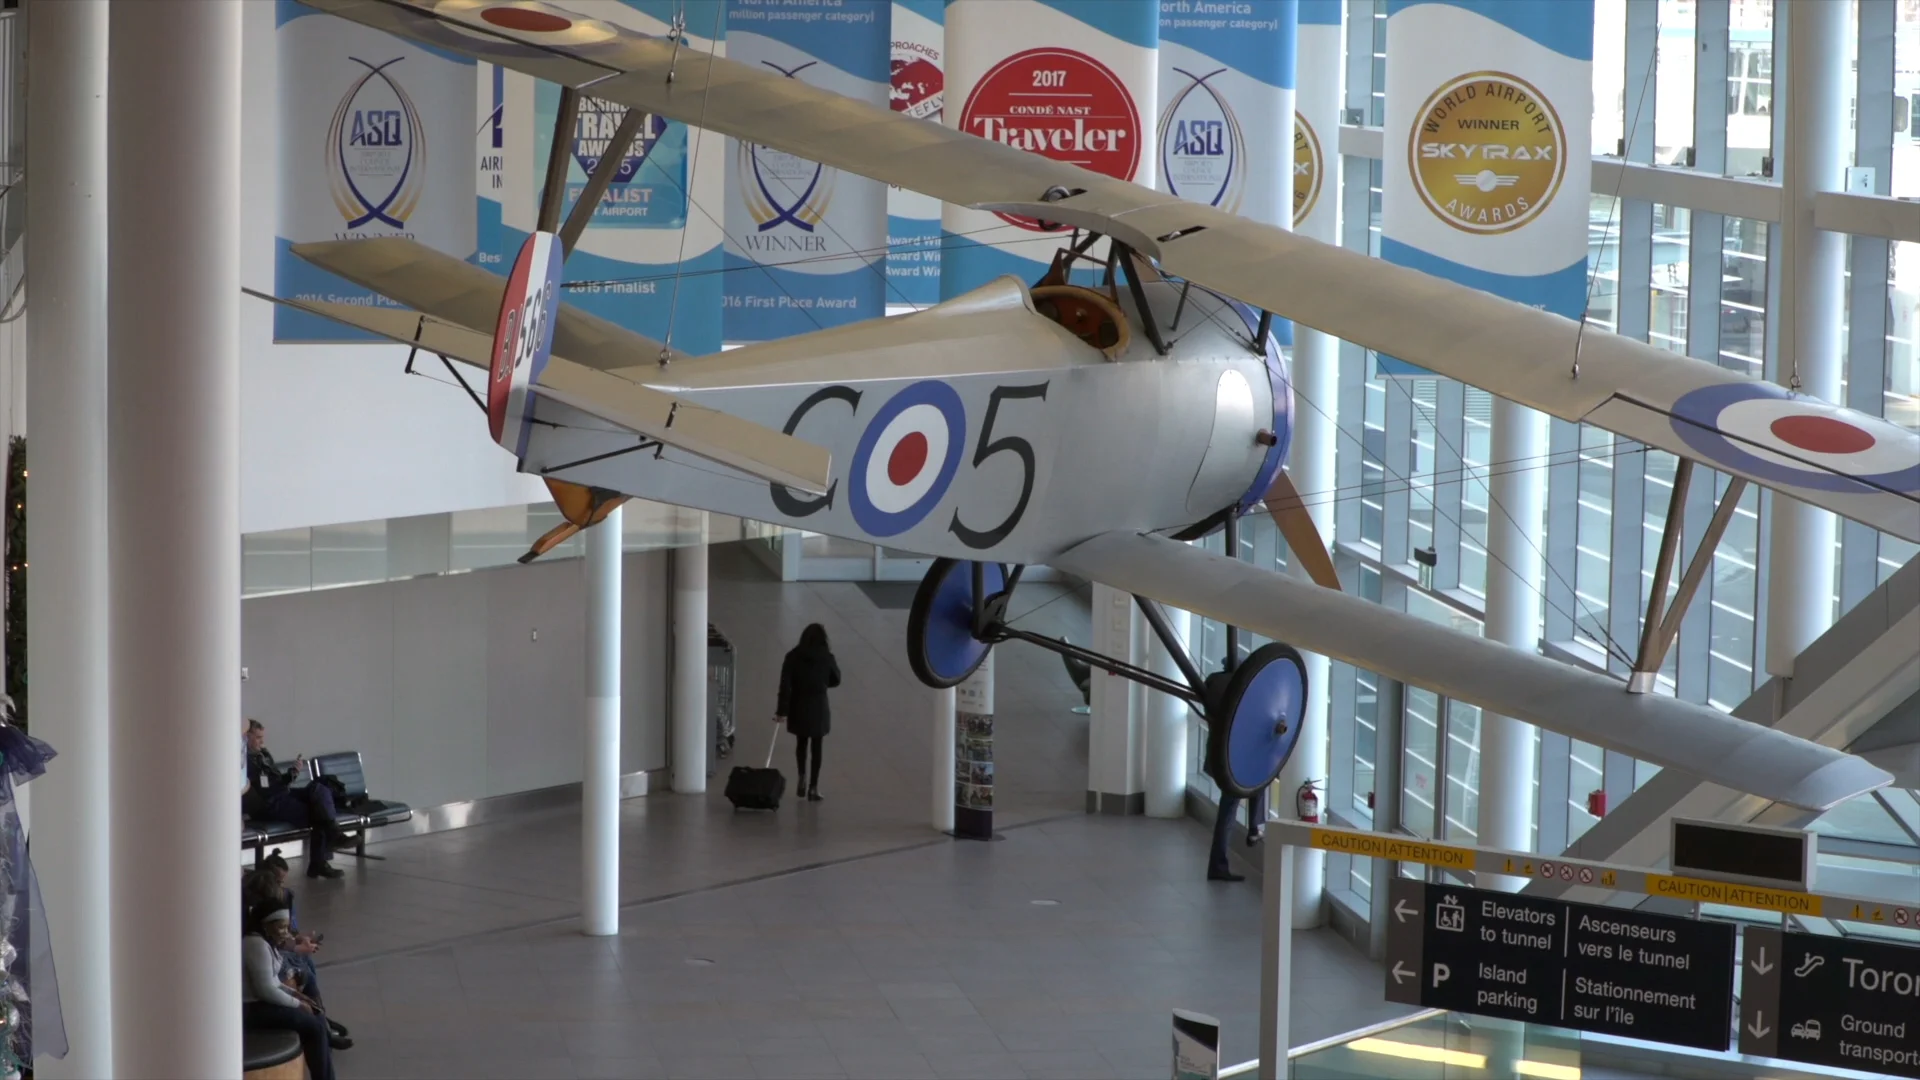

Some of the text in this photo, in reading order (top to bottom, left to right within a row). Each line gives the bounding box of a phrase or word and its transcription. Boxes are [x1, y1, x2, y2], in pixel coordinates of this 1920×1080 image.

[729, 9, 765, 19] million
[768, 11, 821, 22] passenger
[1159, 0, 1251, 14] orth America
[1173, 19, 1226, 29] passenger
[1032, 70, 1067, 87] 2017
[1009, 104, 1091, 115] CONDÉ NAST
[1424, 83, 1551, 134] WORLD AIRPORT
[349, 110, 402, 146] ASQ
[973, 117, 1127, 152] Traveler
[1457, 119, 1520, 130] WINNER
[1173, 120, 1224, 156] ASQ
[1421, 142, 1552, 160] SKYTRAX
[480, 156, 503, 171] AIR
[587, 158, 632, 174] 25
[602, 207, 648, 217] AIRPORT
[1445, 196, 1529, 222] AWARDS
[745, 235, 827, 252] WINNER
[479, 252, 503, 263] Bes
[604, 281, 656, 294] Finalist
[327, 293, 373, 306] Second
[745, 295, 776, 308] First
[778, 295, 813, 308] Place
[816, 296, 857, 309] Award
[948, 379, 1050, 549] 5
[1321, 832, 1464, 864] CAUTION ATTENTION
[1658, 879, 1810, 911] CAUTION ATTENTION
[1481, 900, 1556, 926] Elevators
[1480, 925, 1552, 950] to tunnel
[1578, 914, 1677, 943] Ascenseurs
[1578, 941, 1690, 970] vers le tunnel
[1479, 962, 1527, 985] Island
[1477, 990, 1537, 1014] parking
[1575, 976, 1697, 1010] Stationnement
[1573, 1004, 1600, 1020] sur
[1841, 1014, 1905, 1038] Ground
